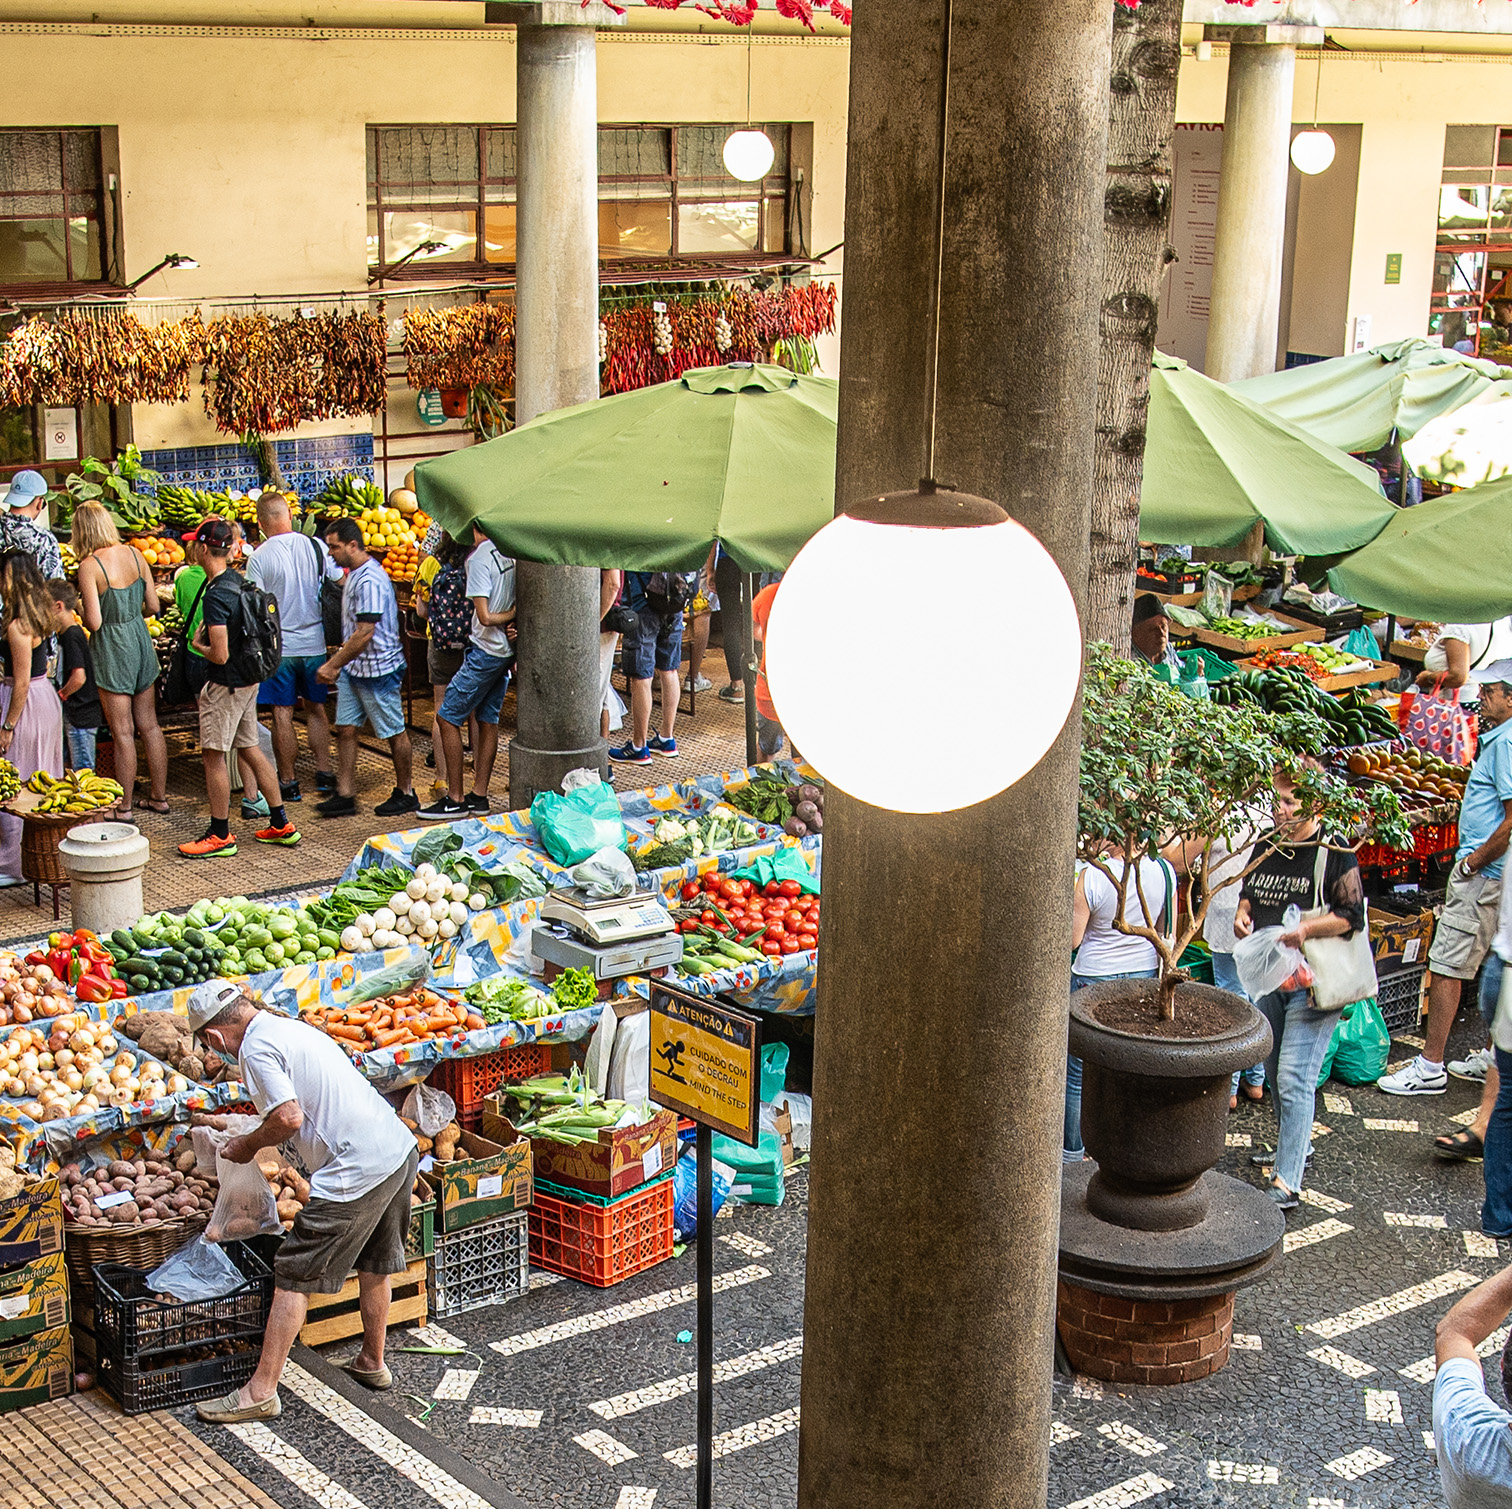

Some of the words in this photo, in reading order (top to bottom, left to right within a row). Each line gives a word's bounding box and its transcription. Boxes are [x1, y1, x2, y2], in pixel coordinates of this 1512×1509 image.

[679, 1005, 723, 1032] ATENÇÃO
[689, 1046, 727, 1069] CUIDADO
[728, 1063, 747, 1079] COM
[698, 1064, 705, 1073] O
[706, 1067, 739, 1088] DEGRAU
[689, 1080, 711, 1094] MIND
[712, 1088, 726, 1100] THE
[728, 1095, 747, 1110] STEP
[460, 1164, 489, 1177] Banana
[494, 1152, 525, 1167] Madeira
[10, 1190, 49, 1207] Madeira
[17, 1265, 53, 1282] Madeira
[21, 1337, 58, 1354] Madeira
